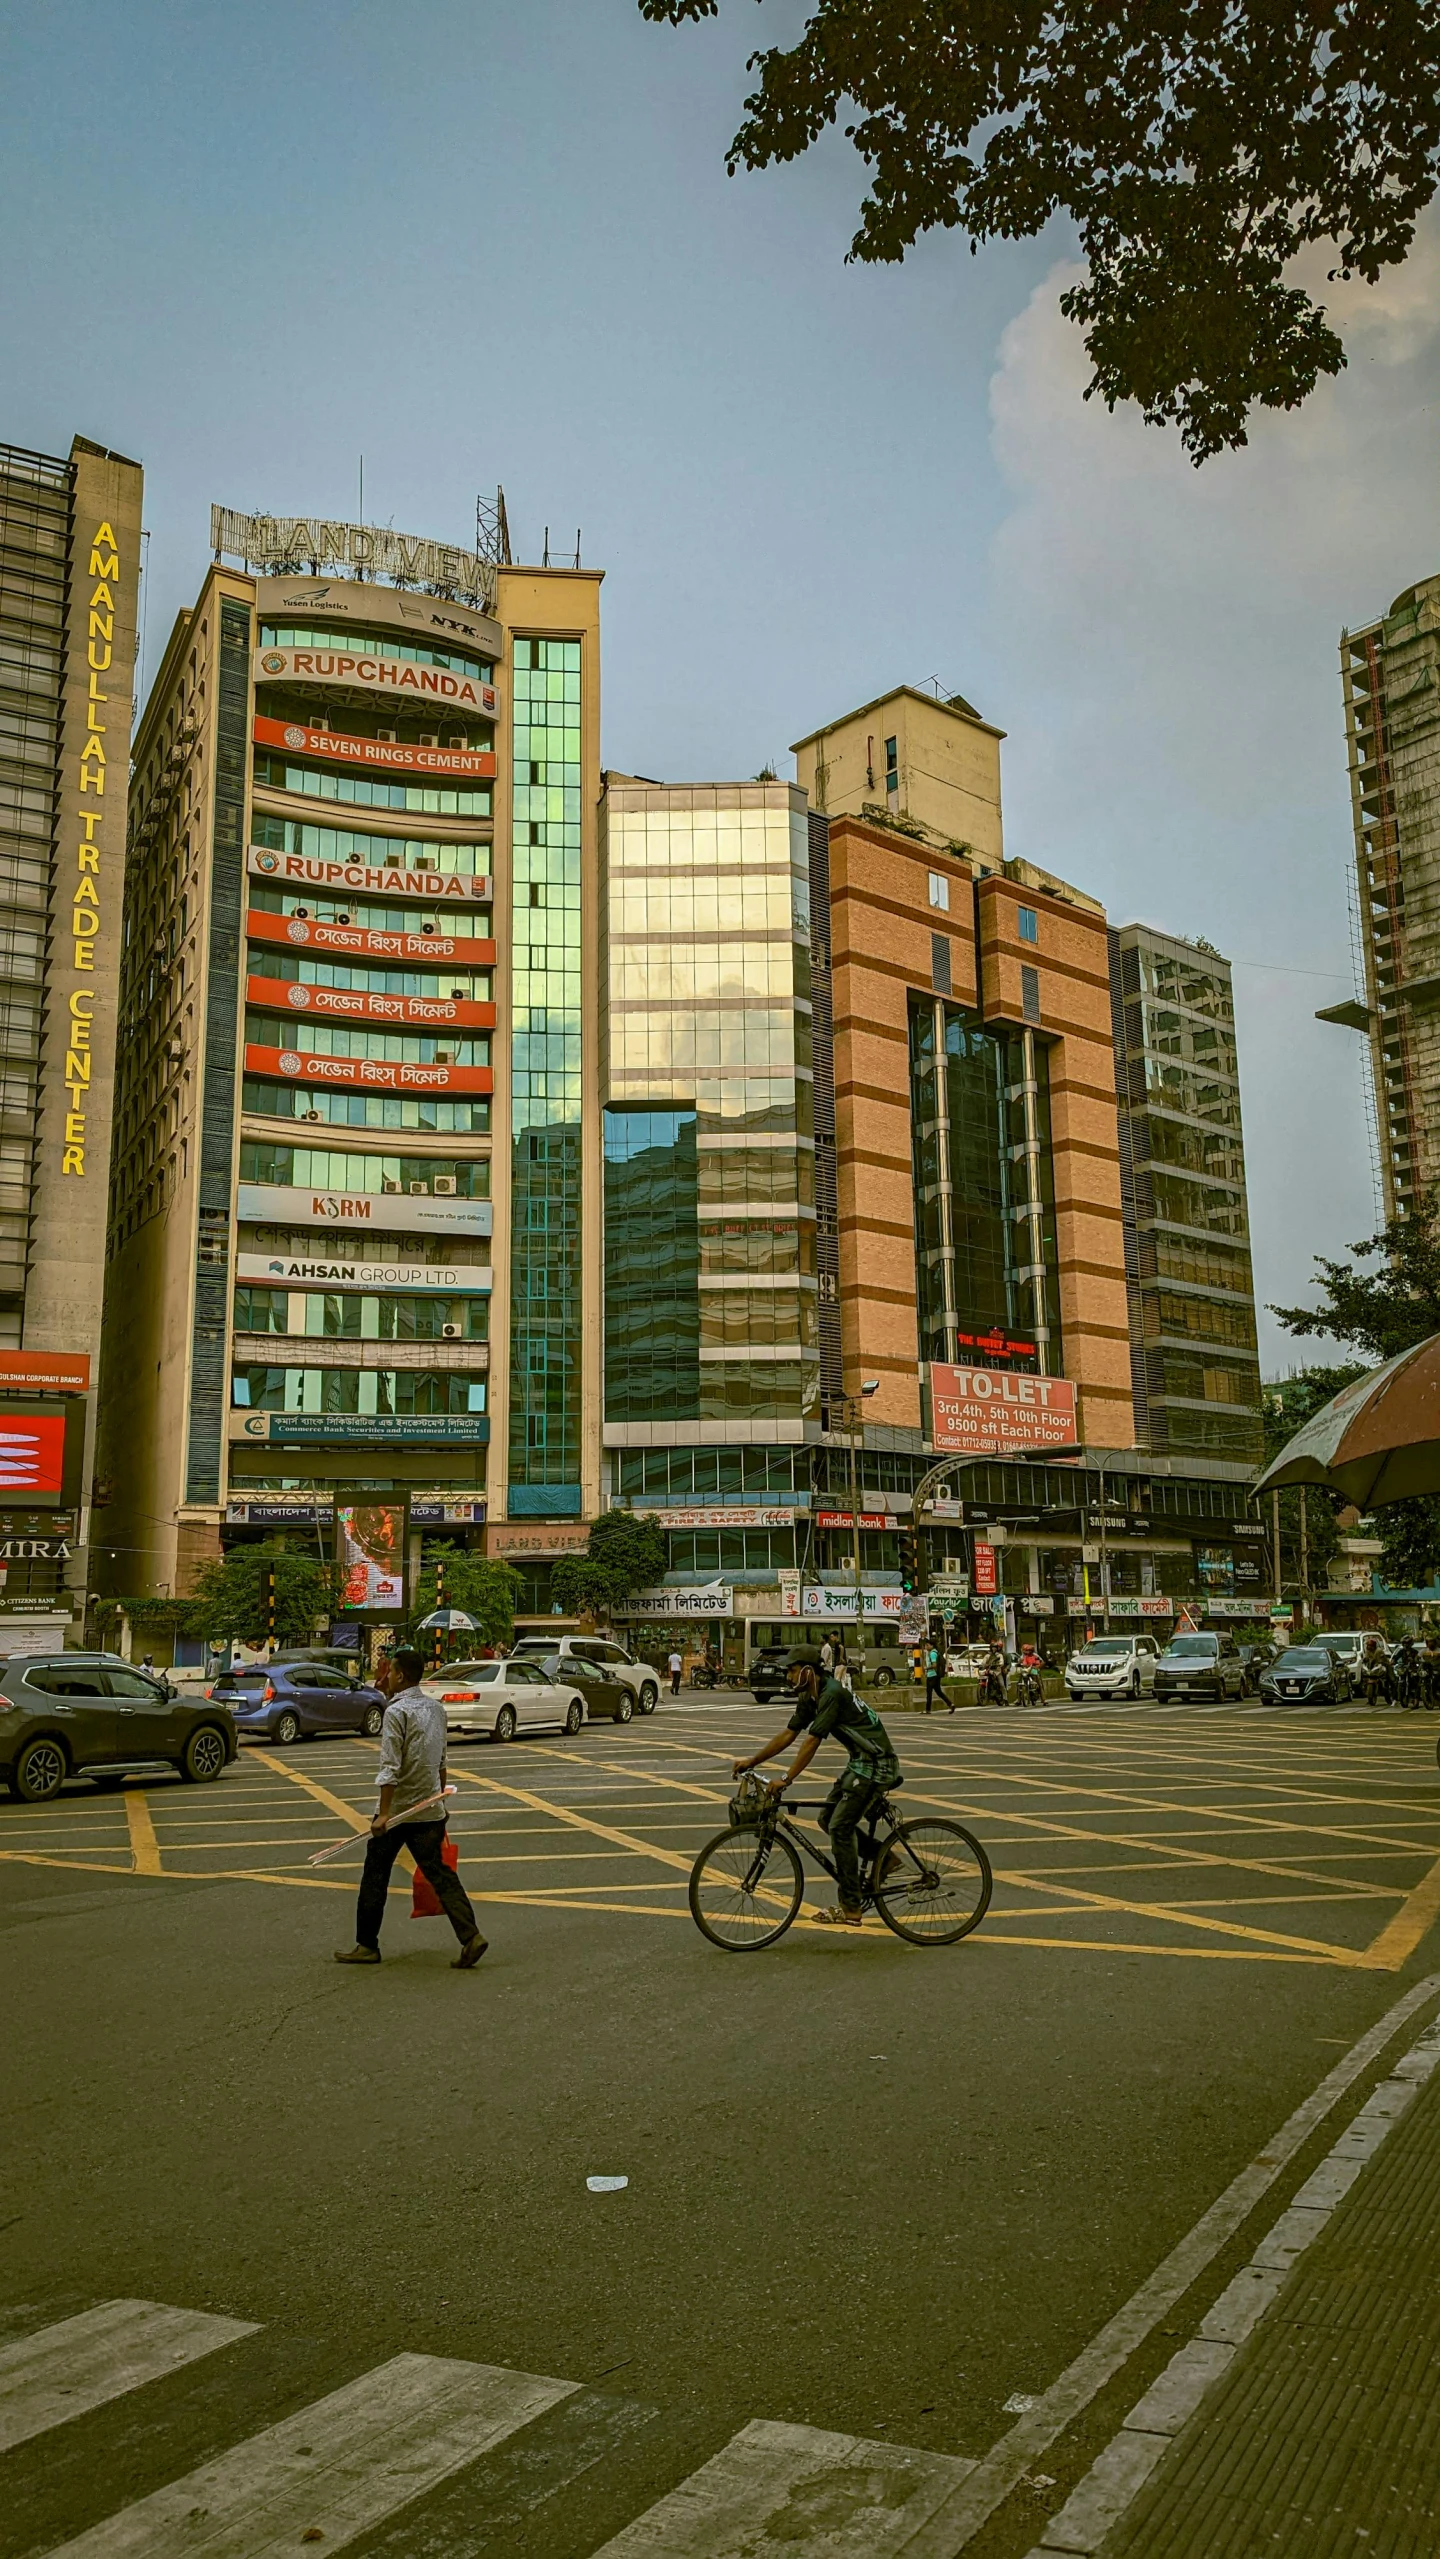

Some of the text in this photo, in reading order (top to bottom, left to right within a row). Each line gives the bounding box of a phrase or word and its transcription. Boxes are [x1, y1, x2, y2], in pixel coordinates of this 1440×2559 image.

[259, 522, 496, 597] LAND VIEW
[282, 599, 349, 610] Yusen Logistics
[431, 613, 477, 637] NYK
[293, 653, 478, 705] RUPCHANDA
[309, 734, 361, 757] SEVEN
[364, 745, 413, 765] RINGS
[416, 752, 482, 771] CEMENT
[62, 521, 119, 1176] AMANULLAH TRADE CENTER
[285, 856, 465, 896] RUPCHANDA
[314, 927, 362, 947] সেভেন
[406, 935, 455, 956] সিমেন্ট
[315, 992, 364, 1011] সেভেন
[409, 999, 457, 1019] সিমেন্ট
[307, 1058, 355, 1078] সেভেন
[400, 1066, 449, 1086] সিমেন্ট
[312, 1197, 371, 1219] KSRM
[288, 1263, 459, 1285] AHSAN GROUP LTD.
[958, 1334, 973, 1345] THE
[0, 1373, 83, 1384] GULSHAN CORPORATE BRANCH
[953, 1369, 1052, 1406] TO-LET
[447, 1418, 481, 1428] লিমিটেড
[990, 1406, 1009, 1421] 5th
[1012, 1409, 1038, 1424] 10th
[1041, 1412, 1072, 1427] Floor
[323, 1425, 345, 1433] Bank
[947, 1417, 1065, 1441] 9500 sft Each Floor
[253, 1507, 311, 1516] বাংলাদেশ
[1233, 1525, 1265, 1535] SAMSUNG
[496, 1538, 542, 1550] LAND
[674, 1593, 729, 1611] লিমিটেড
